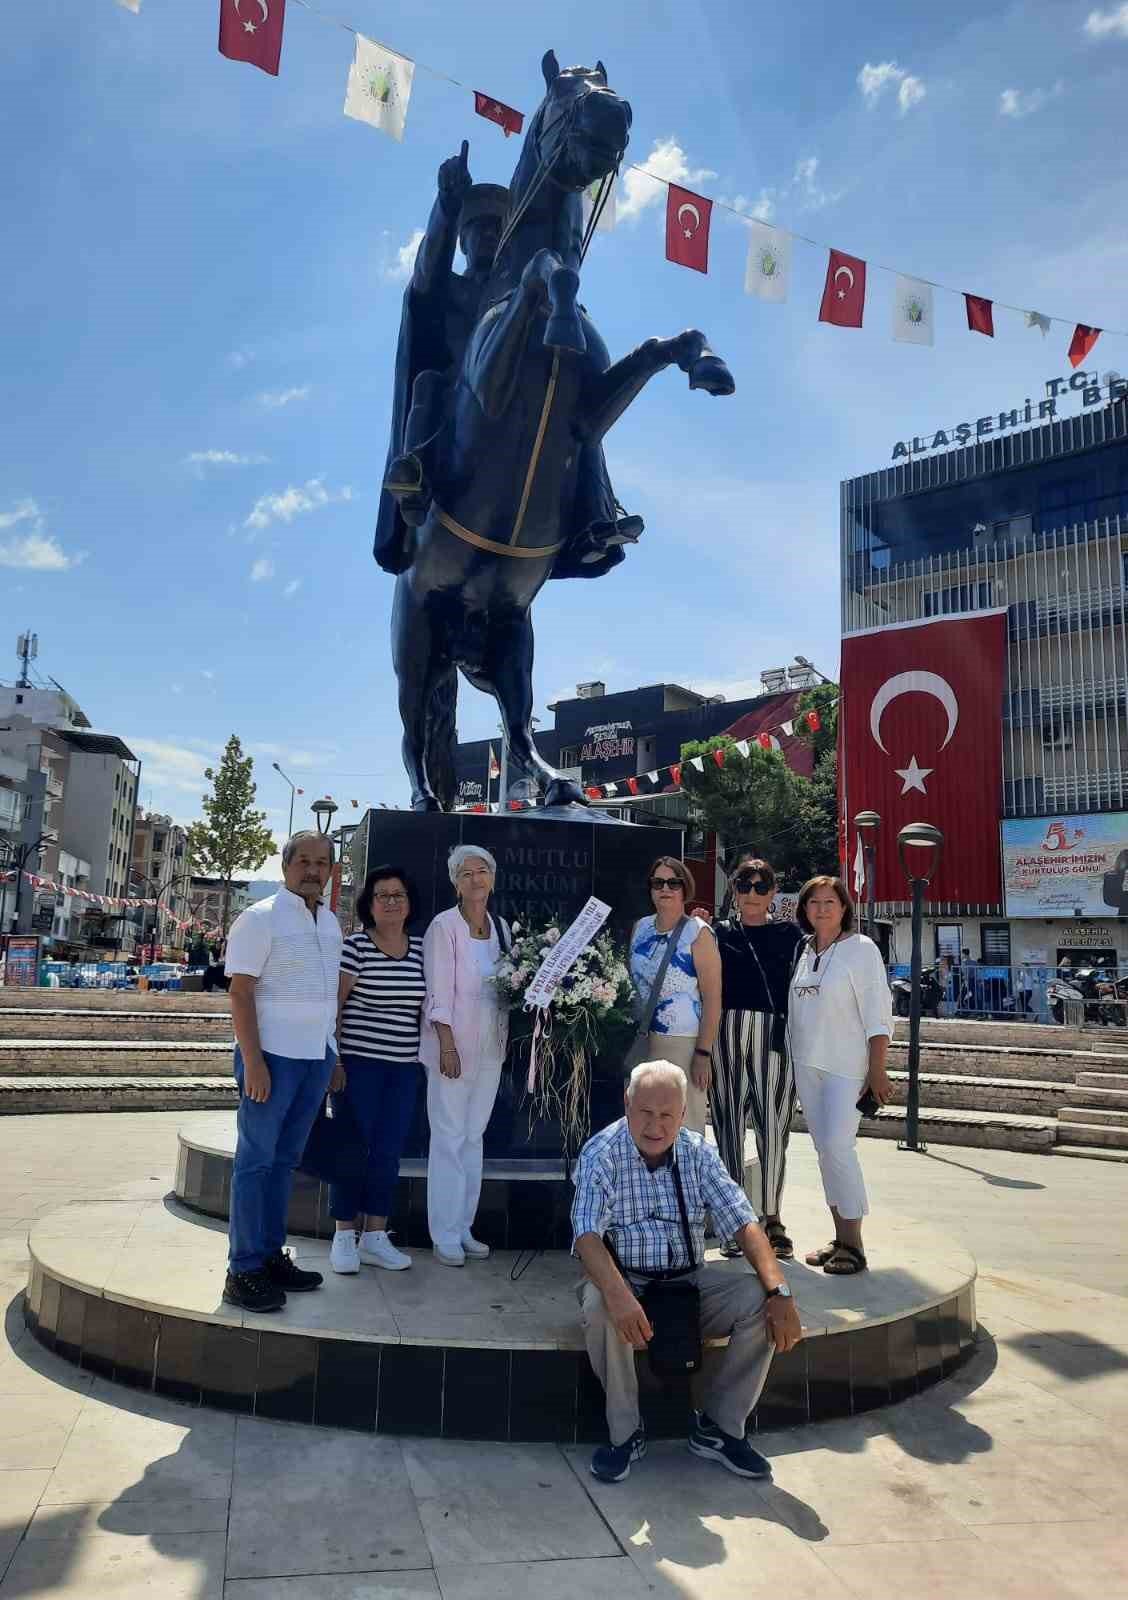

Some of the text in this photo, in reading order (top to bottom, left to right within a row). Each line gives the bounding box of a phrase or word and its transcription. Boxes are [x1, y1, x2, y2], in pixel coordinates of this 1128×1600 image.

[1046, 371, 1098, 398] T.C.
[891, 398, 1057, 460] ALAŞEHİR
[504, 847, 592, 868] MUTLU
[495, 867, 577, 894] ÜRKÜM
